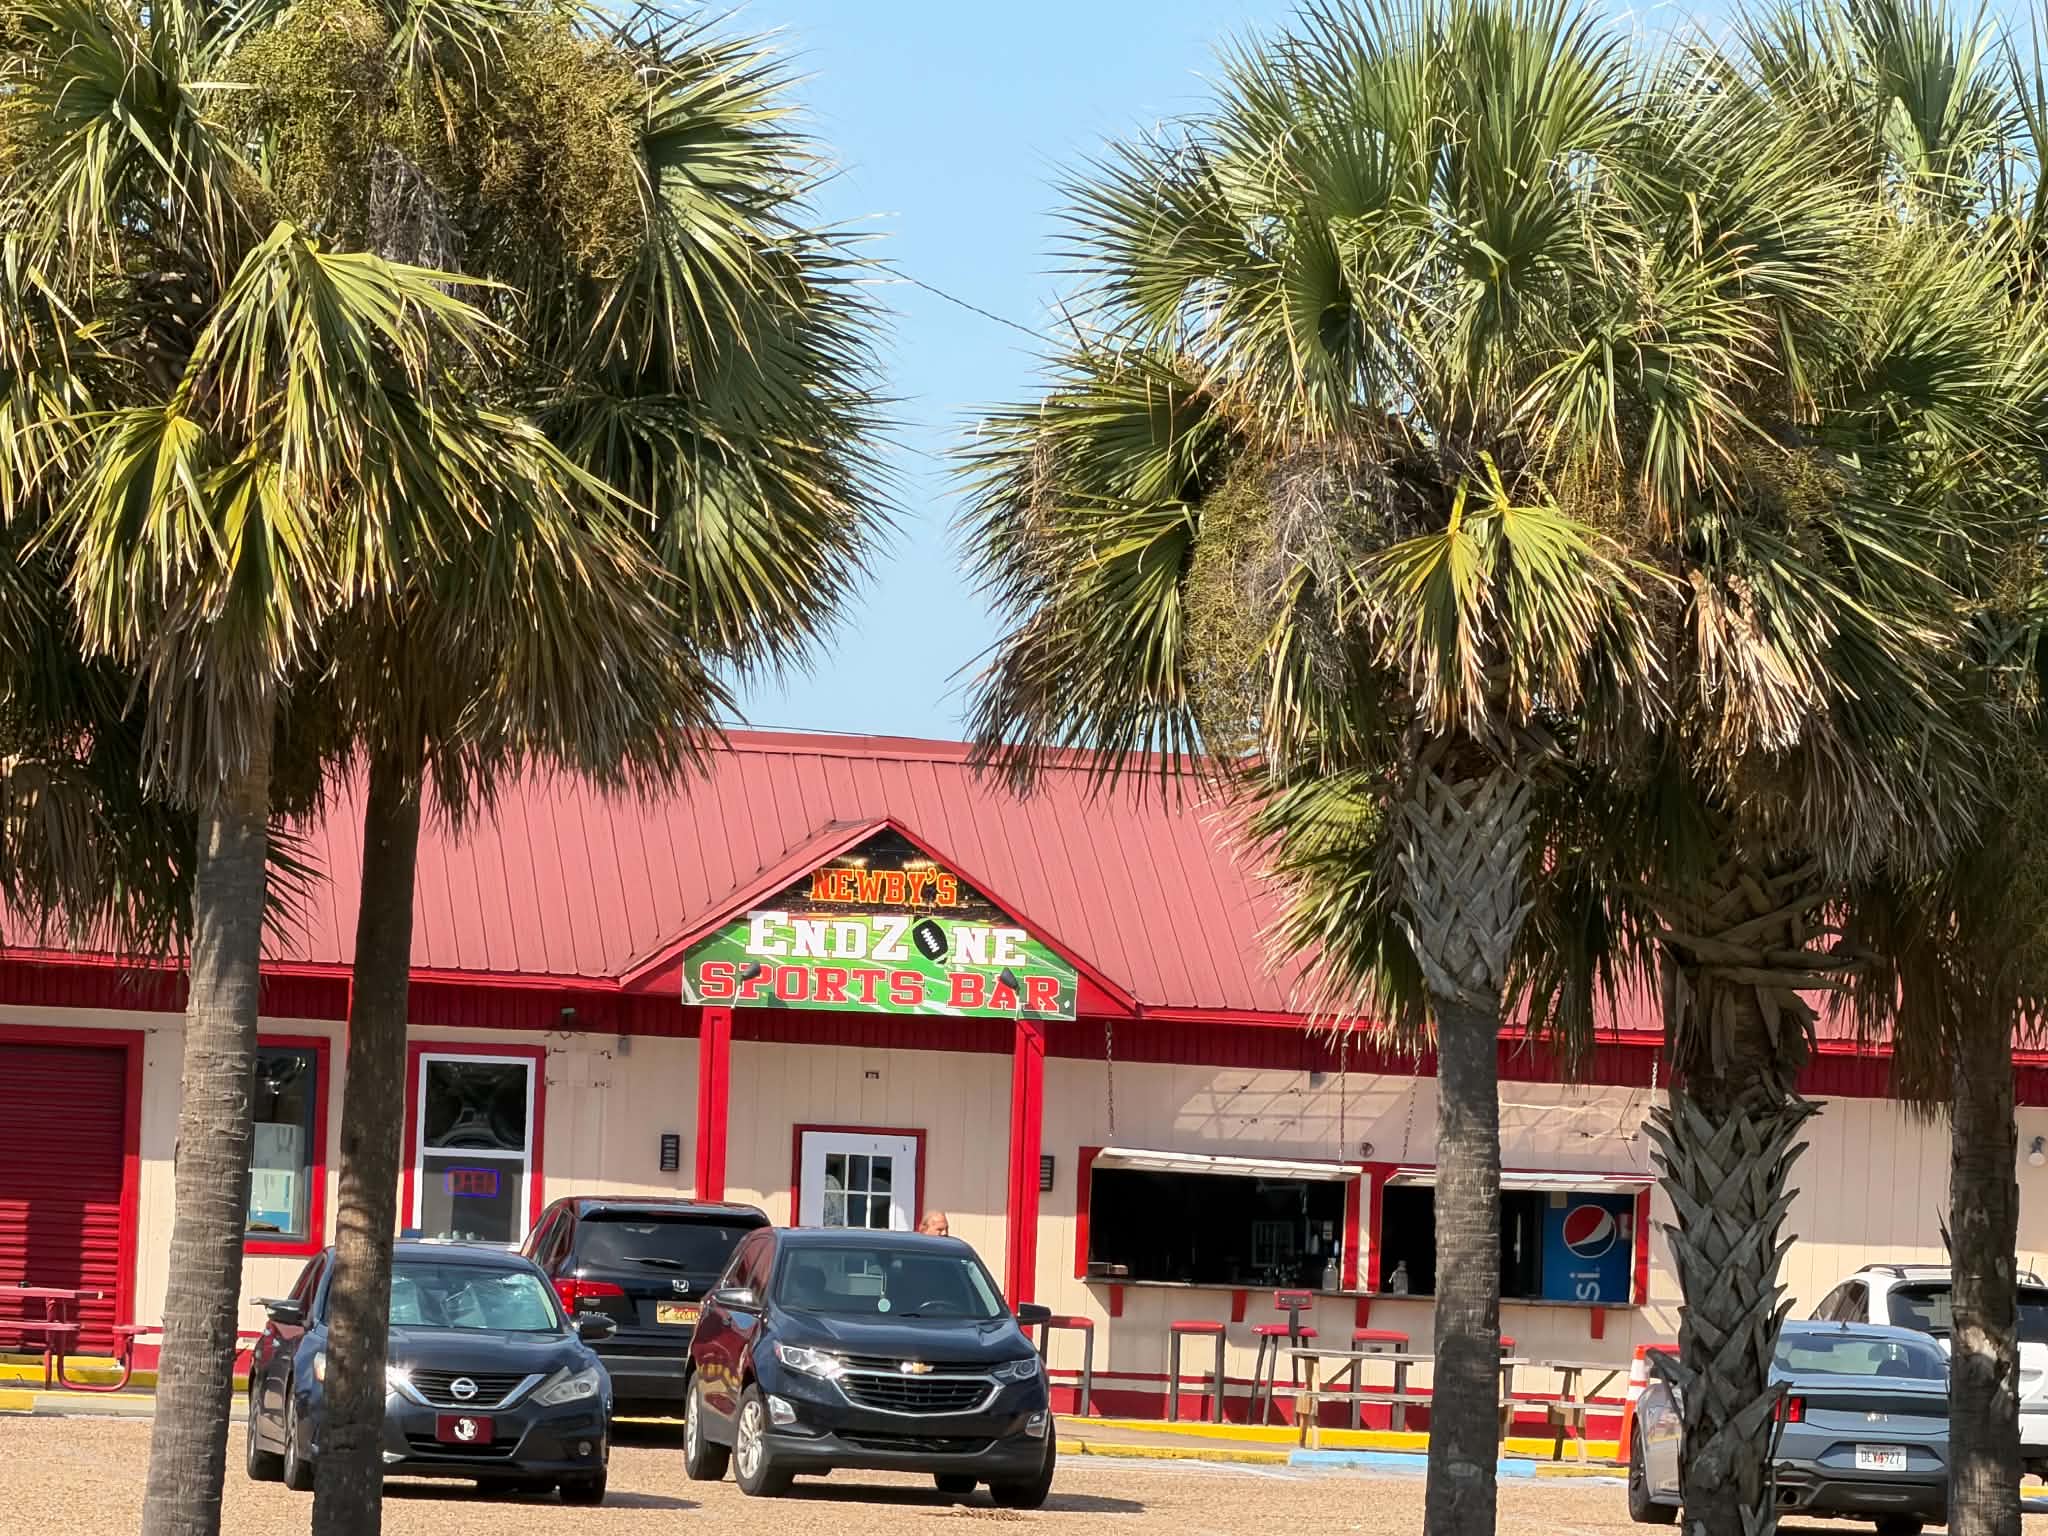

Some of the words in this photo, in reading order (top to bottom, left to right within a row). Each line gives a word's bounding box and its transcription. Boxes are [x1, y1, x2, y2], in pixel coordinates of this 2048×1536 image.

[810, 867, 957, 906] NEWBY'S
[700, 961, 925, 1007] SPORTS
[946, 971, 1060, 1012] BAR
